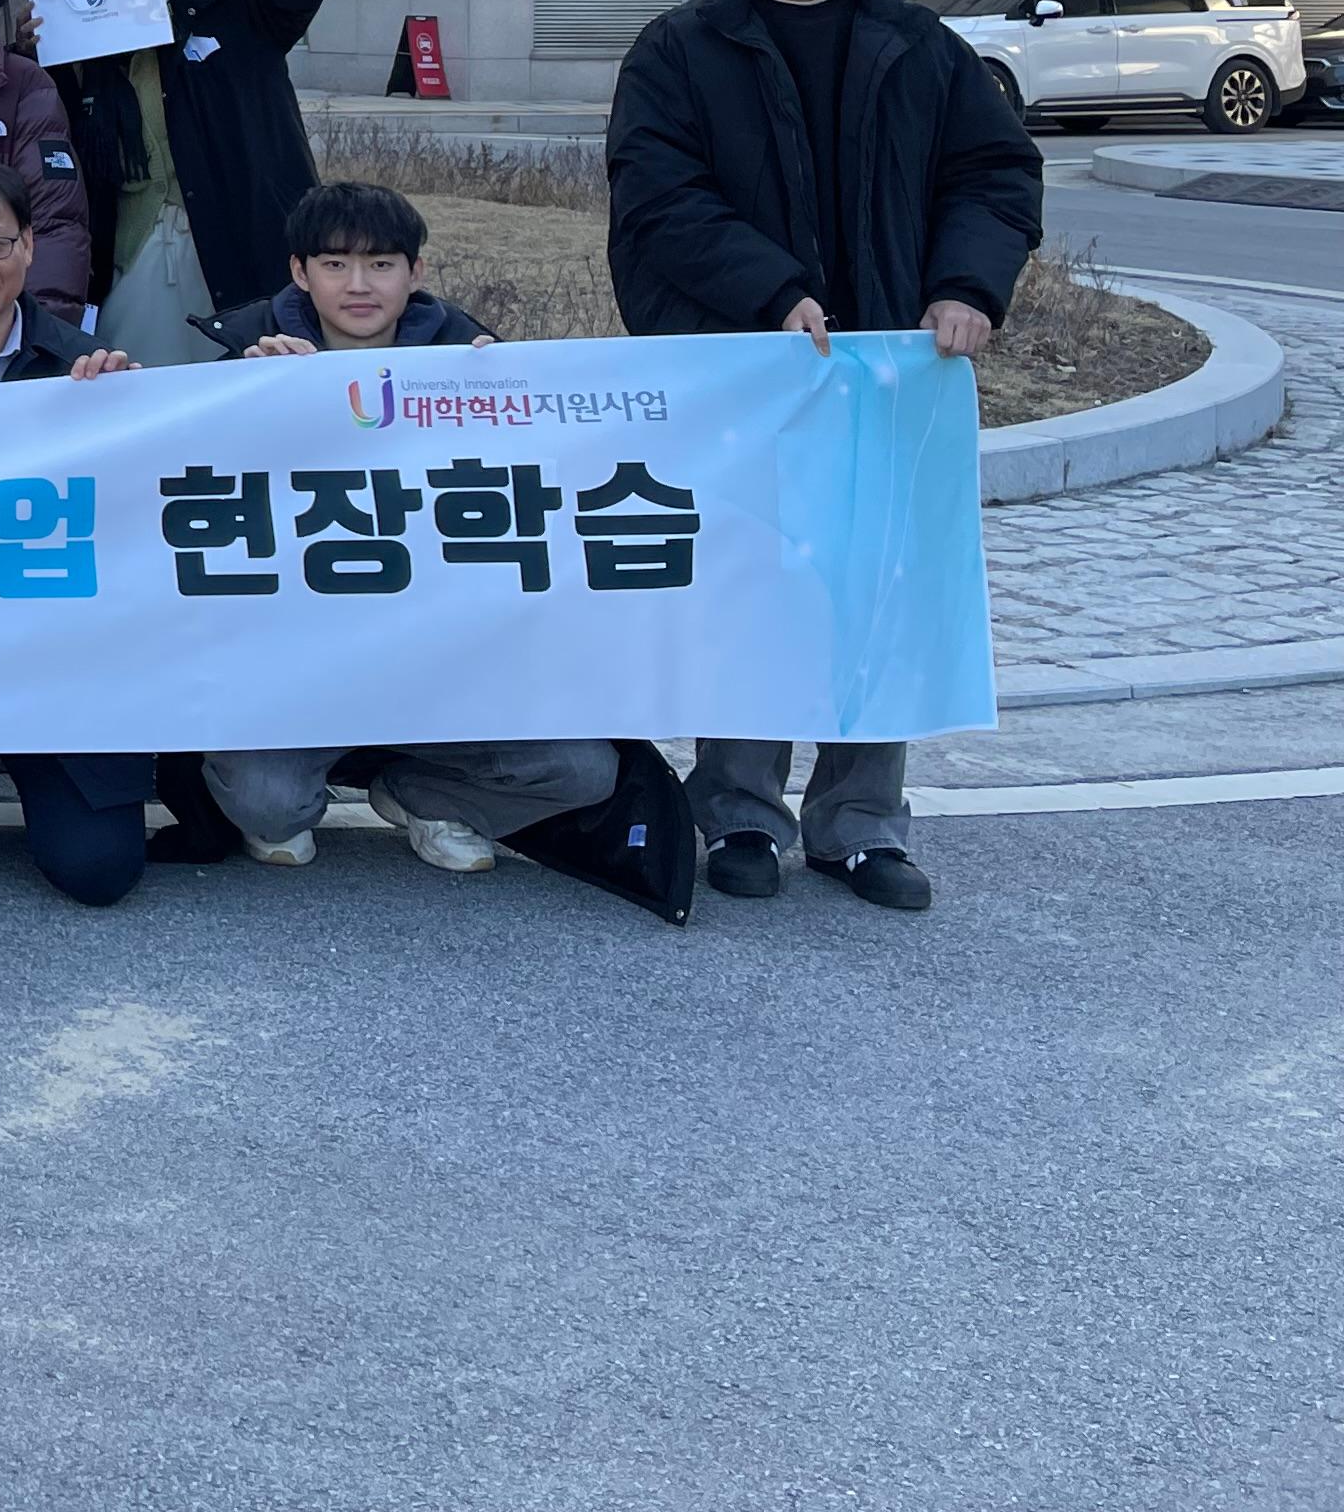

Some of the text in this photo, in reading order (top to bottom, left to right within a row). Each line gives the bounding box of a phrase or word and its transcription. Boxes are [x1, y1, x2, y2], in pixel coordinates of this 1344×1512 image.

[400, 377, 529, 393] University Innovation
[403, 390, 669, 428] 대학혁신지원사업
[159, 457, 701, 597] 현장학습
